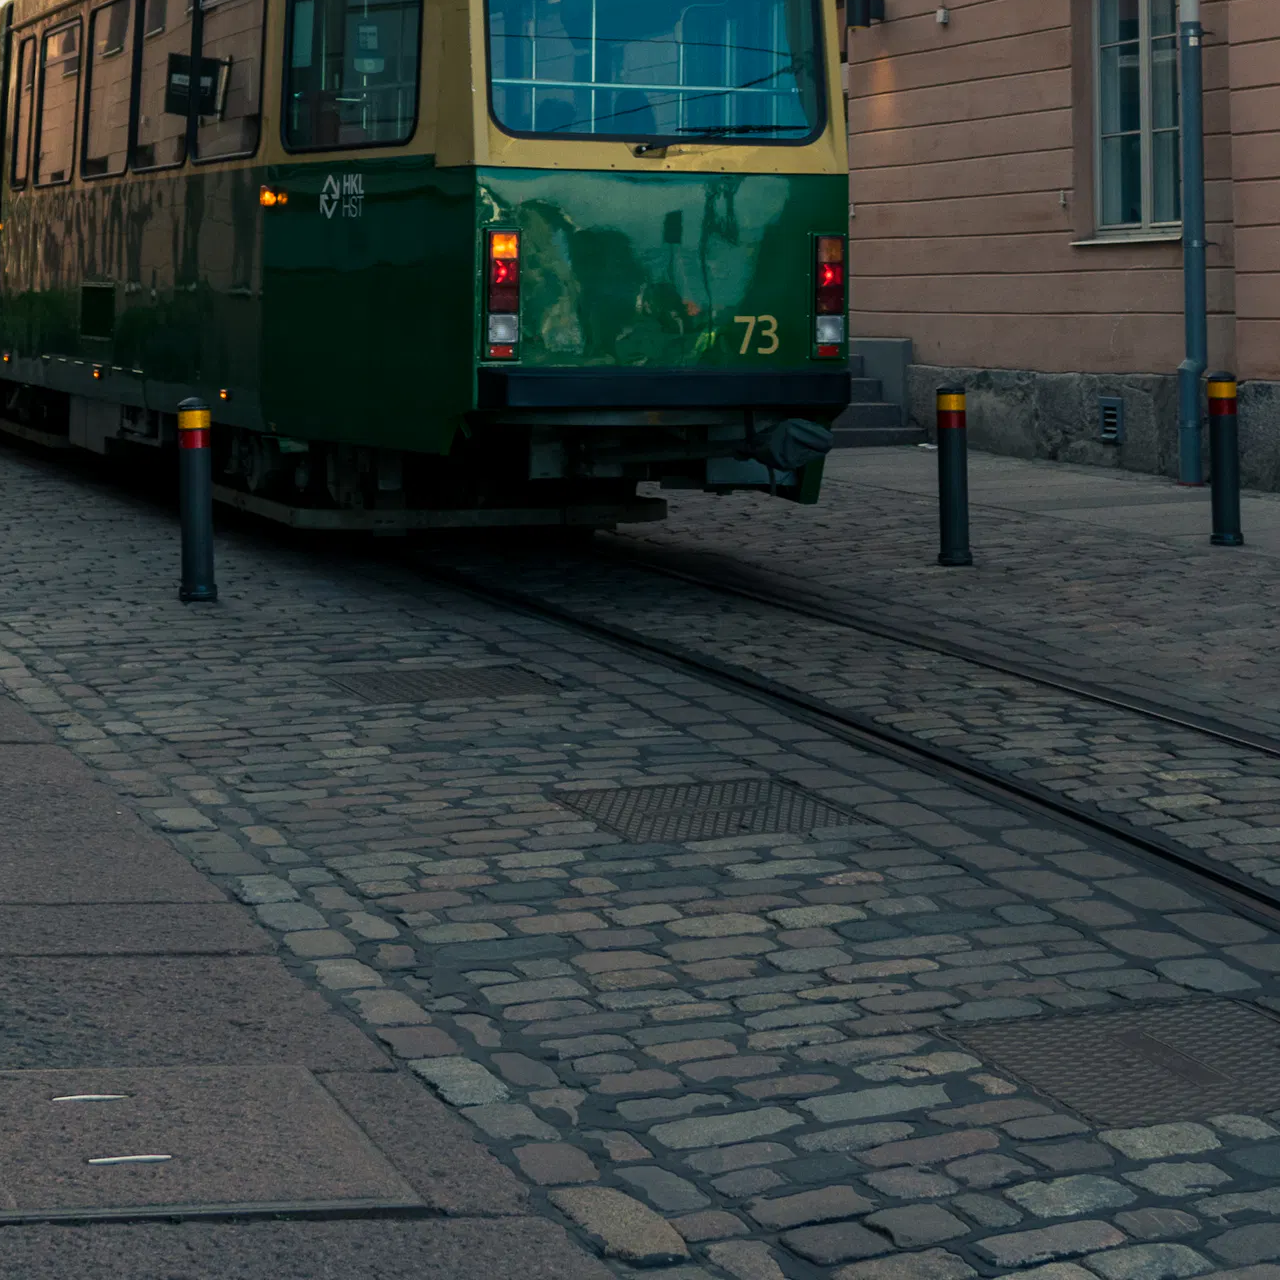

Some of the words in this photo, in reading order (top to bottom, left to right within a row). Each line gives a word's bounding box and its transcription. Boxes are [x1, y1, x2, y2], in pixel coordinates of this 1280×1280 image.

[342, 173, 364, 195] HKL
[341, 195, 364, 218] HST
[733, 314, 780, 355] 73
